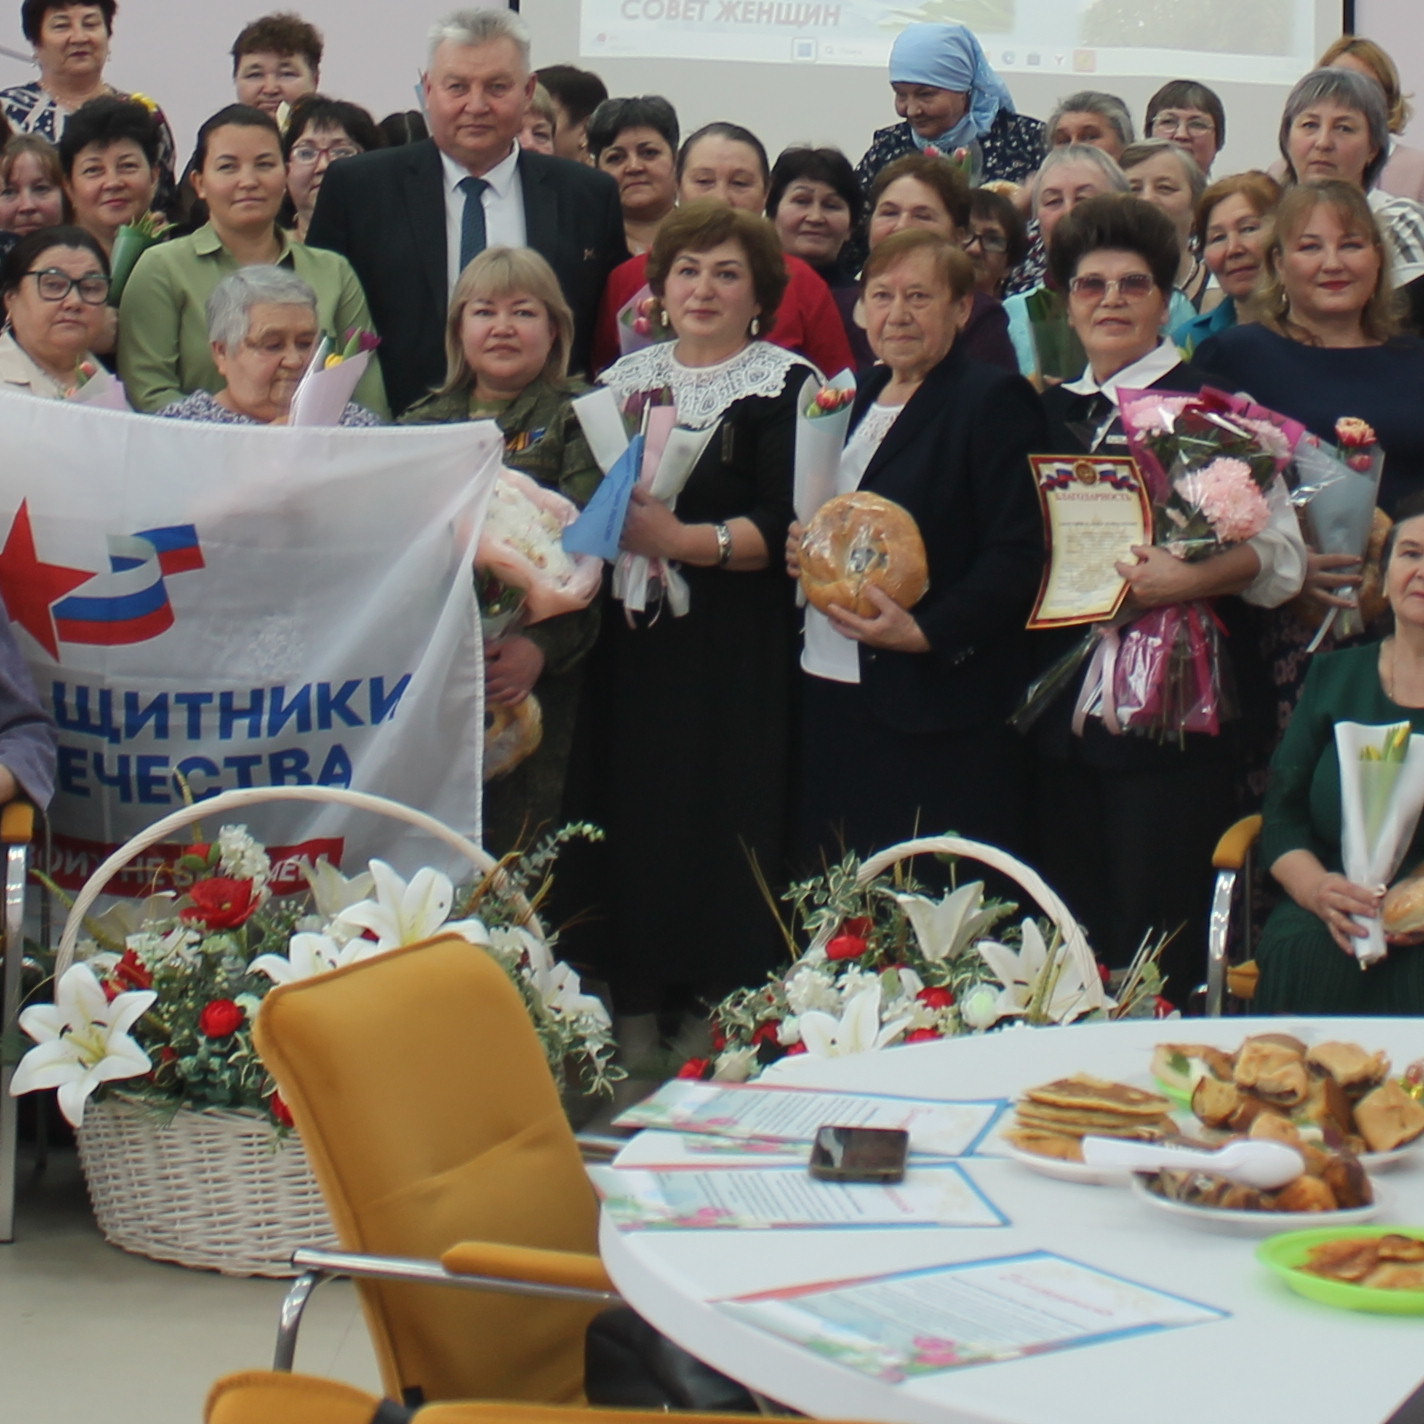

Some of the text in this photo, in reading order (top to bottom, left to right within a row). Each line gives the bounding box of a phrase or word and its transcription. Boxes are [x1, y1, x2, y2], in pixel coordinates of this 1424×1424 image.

[714, 0, 843, 27] ЖЕНЩИН
[52, 672, 413, 744] ЩИТНИКИ
[57, 743, 353, 805] ЕЧЕСТВА
